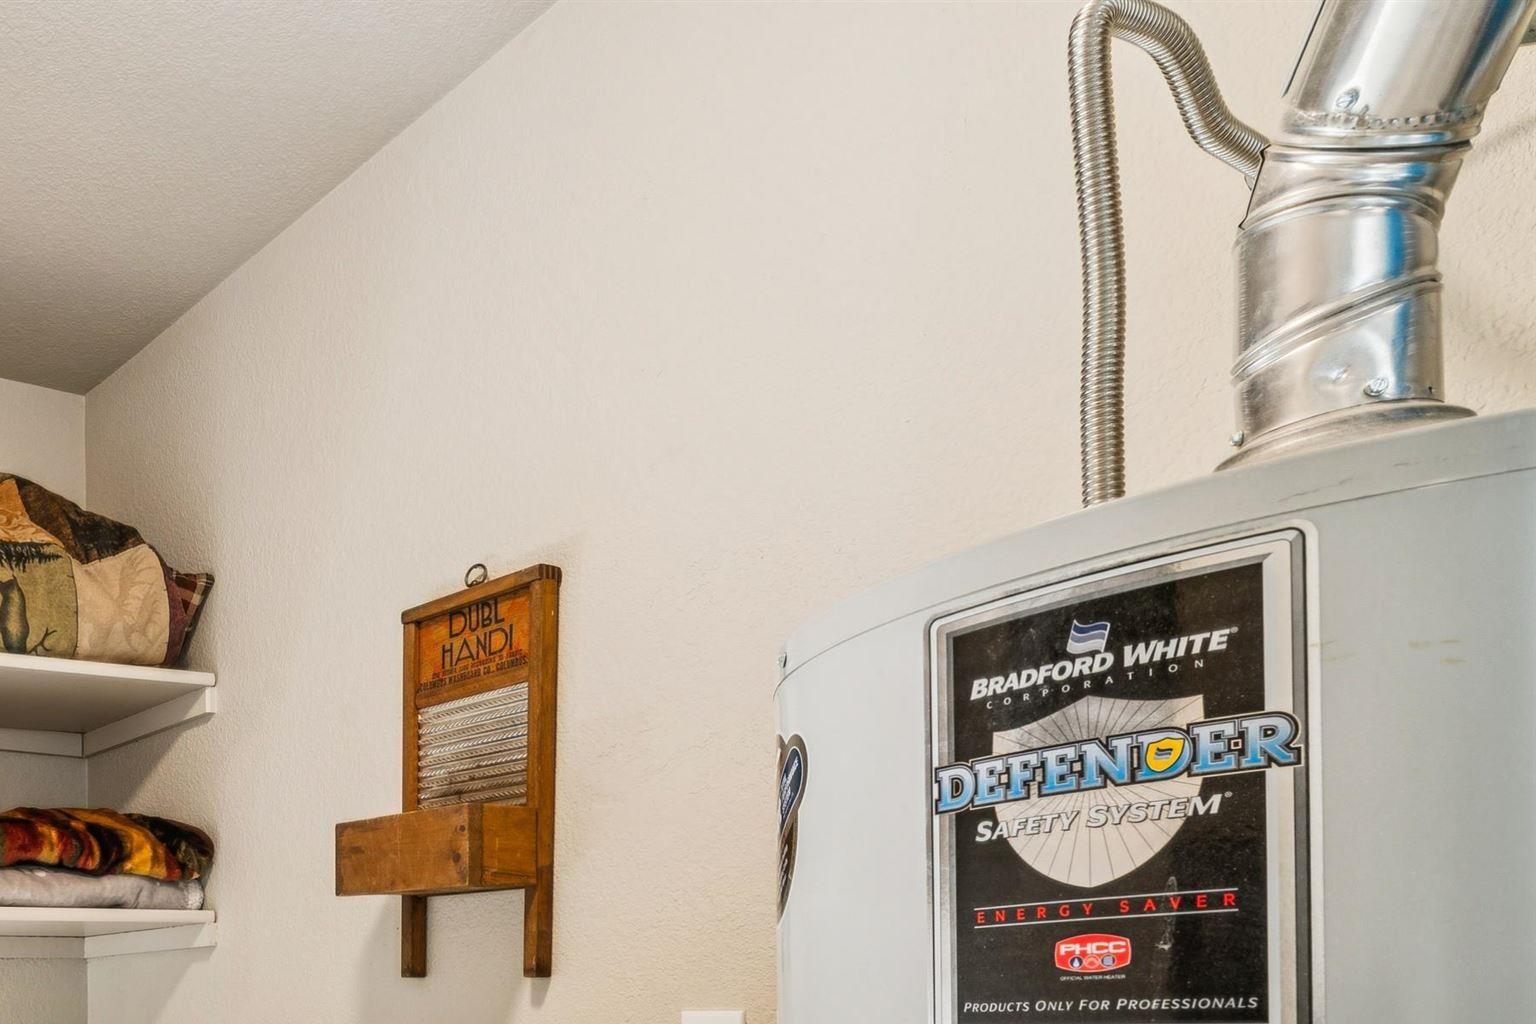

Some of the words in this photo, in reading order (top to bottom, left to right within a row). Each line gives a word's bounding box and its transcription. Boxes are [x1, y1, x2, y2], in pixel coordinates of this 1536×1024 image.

[448, 598, 504, 638] DUBL
[441, 624, 513, 669] HANDI
[970, 653, 1114, 700] BRADFORD
[986, 659, 1204, 710] CORPORATION
[935, 711, 1302, 814] DEFENDER
[975, 809, 1079, 843] SAFETY
[977, 902, 1094, 924] ENERGY
[1120, 892, 1237, 914] SAVER
[1059, 941, 1126, 956] PHCC
[964, 1001, 1030, 1014] PRODUCTS
[1035, 1000, 1073, 1013] ONLY
[1079, 999, 1110, 1012] FOR
[1116, 997, 1258, 1012] PROFESSIONALS
